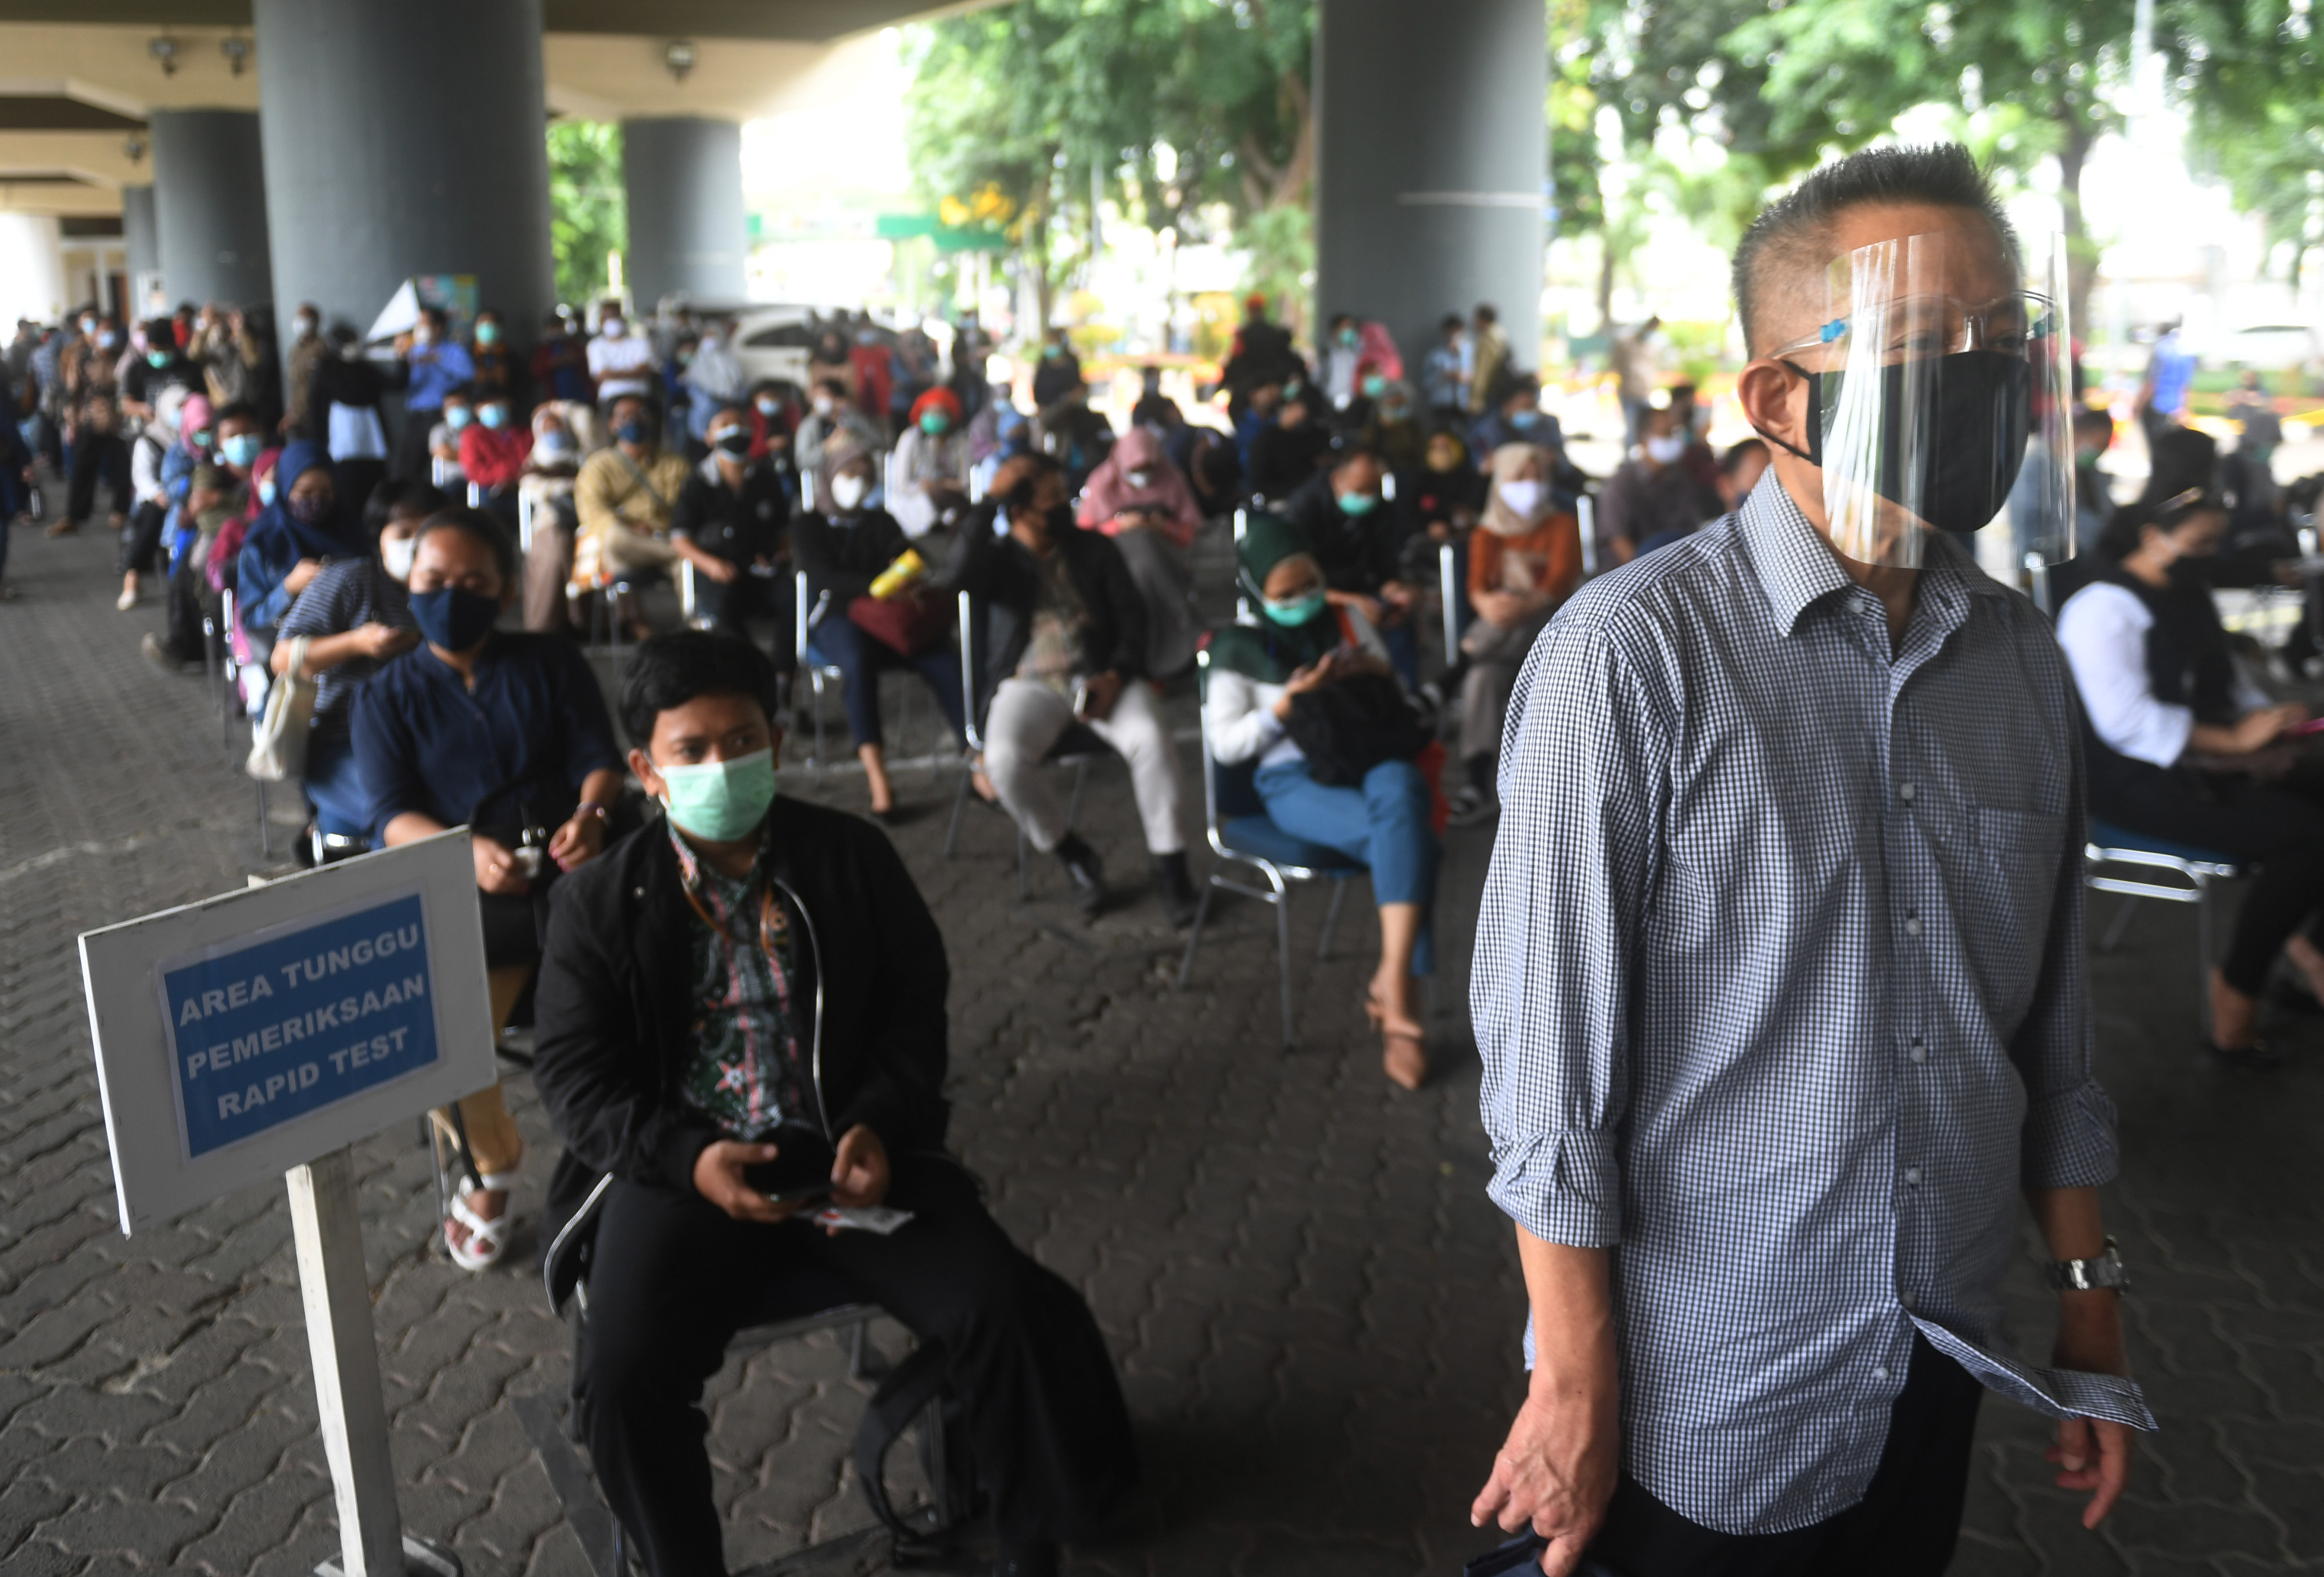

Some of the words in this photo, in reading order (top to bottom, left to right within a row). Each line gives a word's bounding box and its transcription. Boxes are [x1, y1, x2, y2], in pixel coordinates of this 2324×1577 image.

[180, 974, 272, 1027] AREA
[282, 923, 418, 987] TUNGGU
[187, 974, 424, 1079] PEMERIKSAAN
[217, 1062, 320, 1120] RAPID
[329, 1027, 408, 1075] TEST
